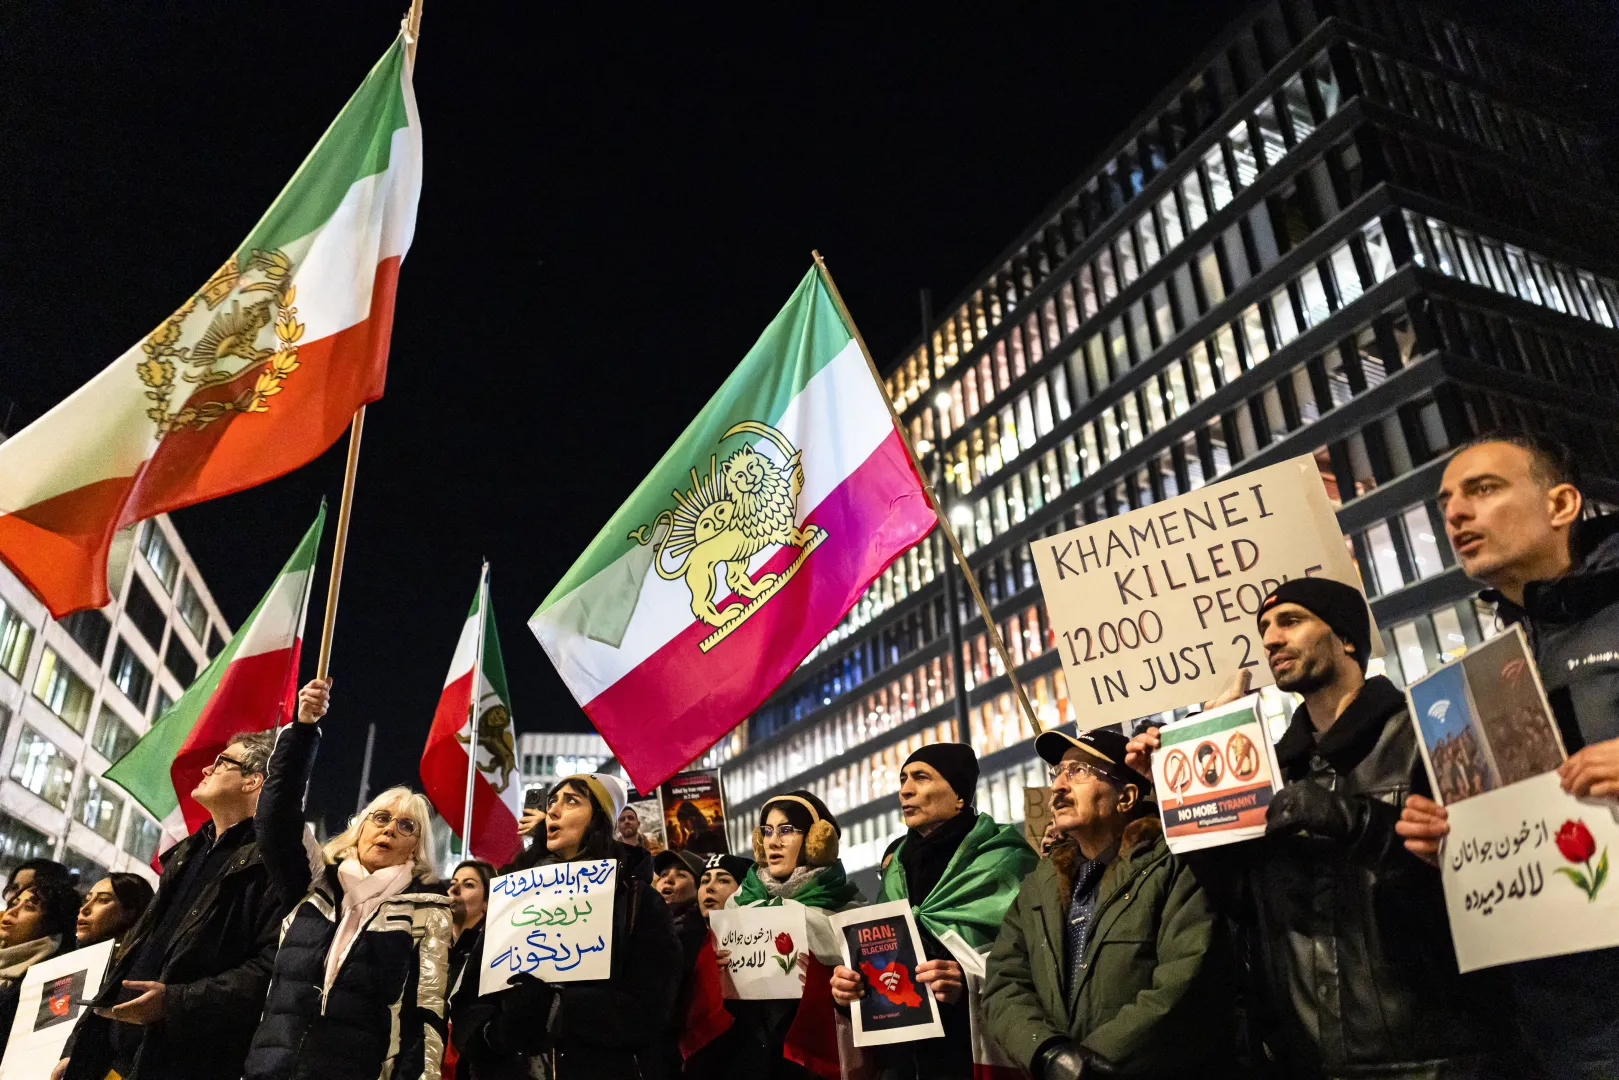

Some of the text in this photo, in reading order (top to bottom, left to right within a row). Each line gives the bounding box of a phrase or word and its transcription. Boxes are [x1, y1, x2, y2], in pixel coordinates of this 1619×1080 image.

[1051, 484, 1273, 580] KHAMENEI
[1114, 538, 1260, 605] KILLED
[1090, 634, 1259, 705] IN JUST 2
[1178, 793, 1256, 822] NO MORE TYRANNY
[1452, 818, 1548, 872] از خون جوانان
[706, 853, 725, 868] H
[1507, 861, 1544, 899] لاله
[722, 927, 773, 946] از خون جوانان
[858, 925, 896, 943] IRAN:
[746, 950, 766, 968] لاله
[861, 942, 897, 956] BLACKOUT
